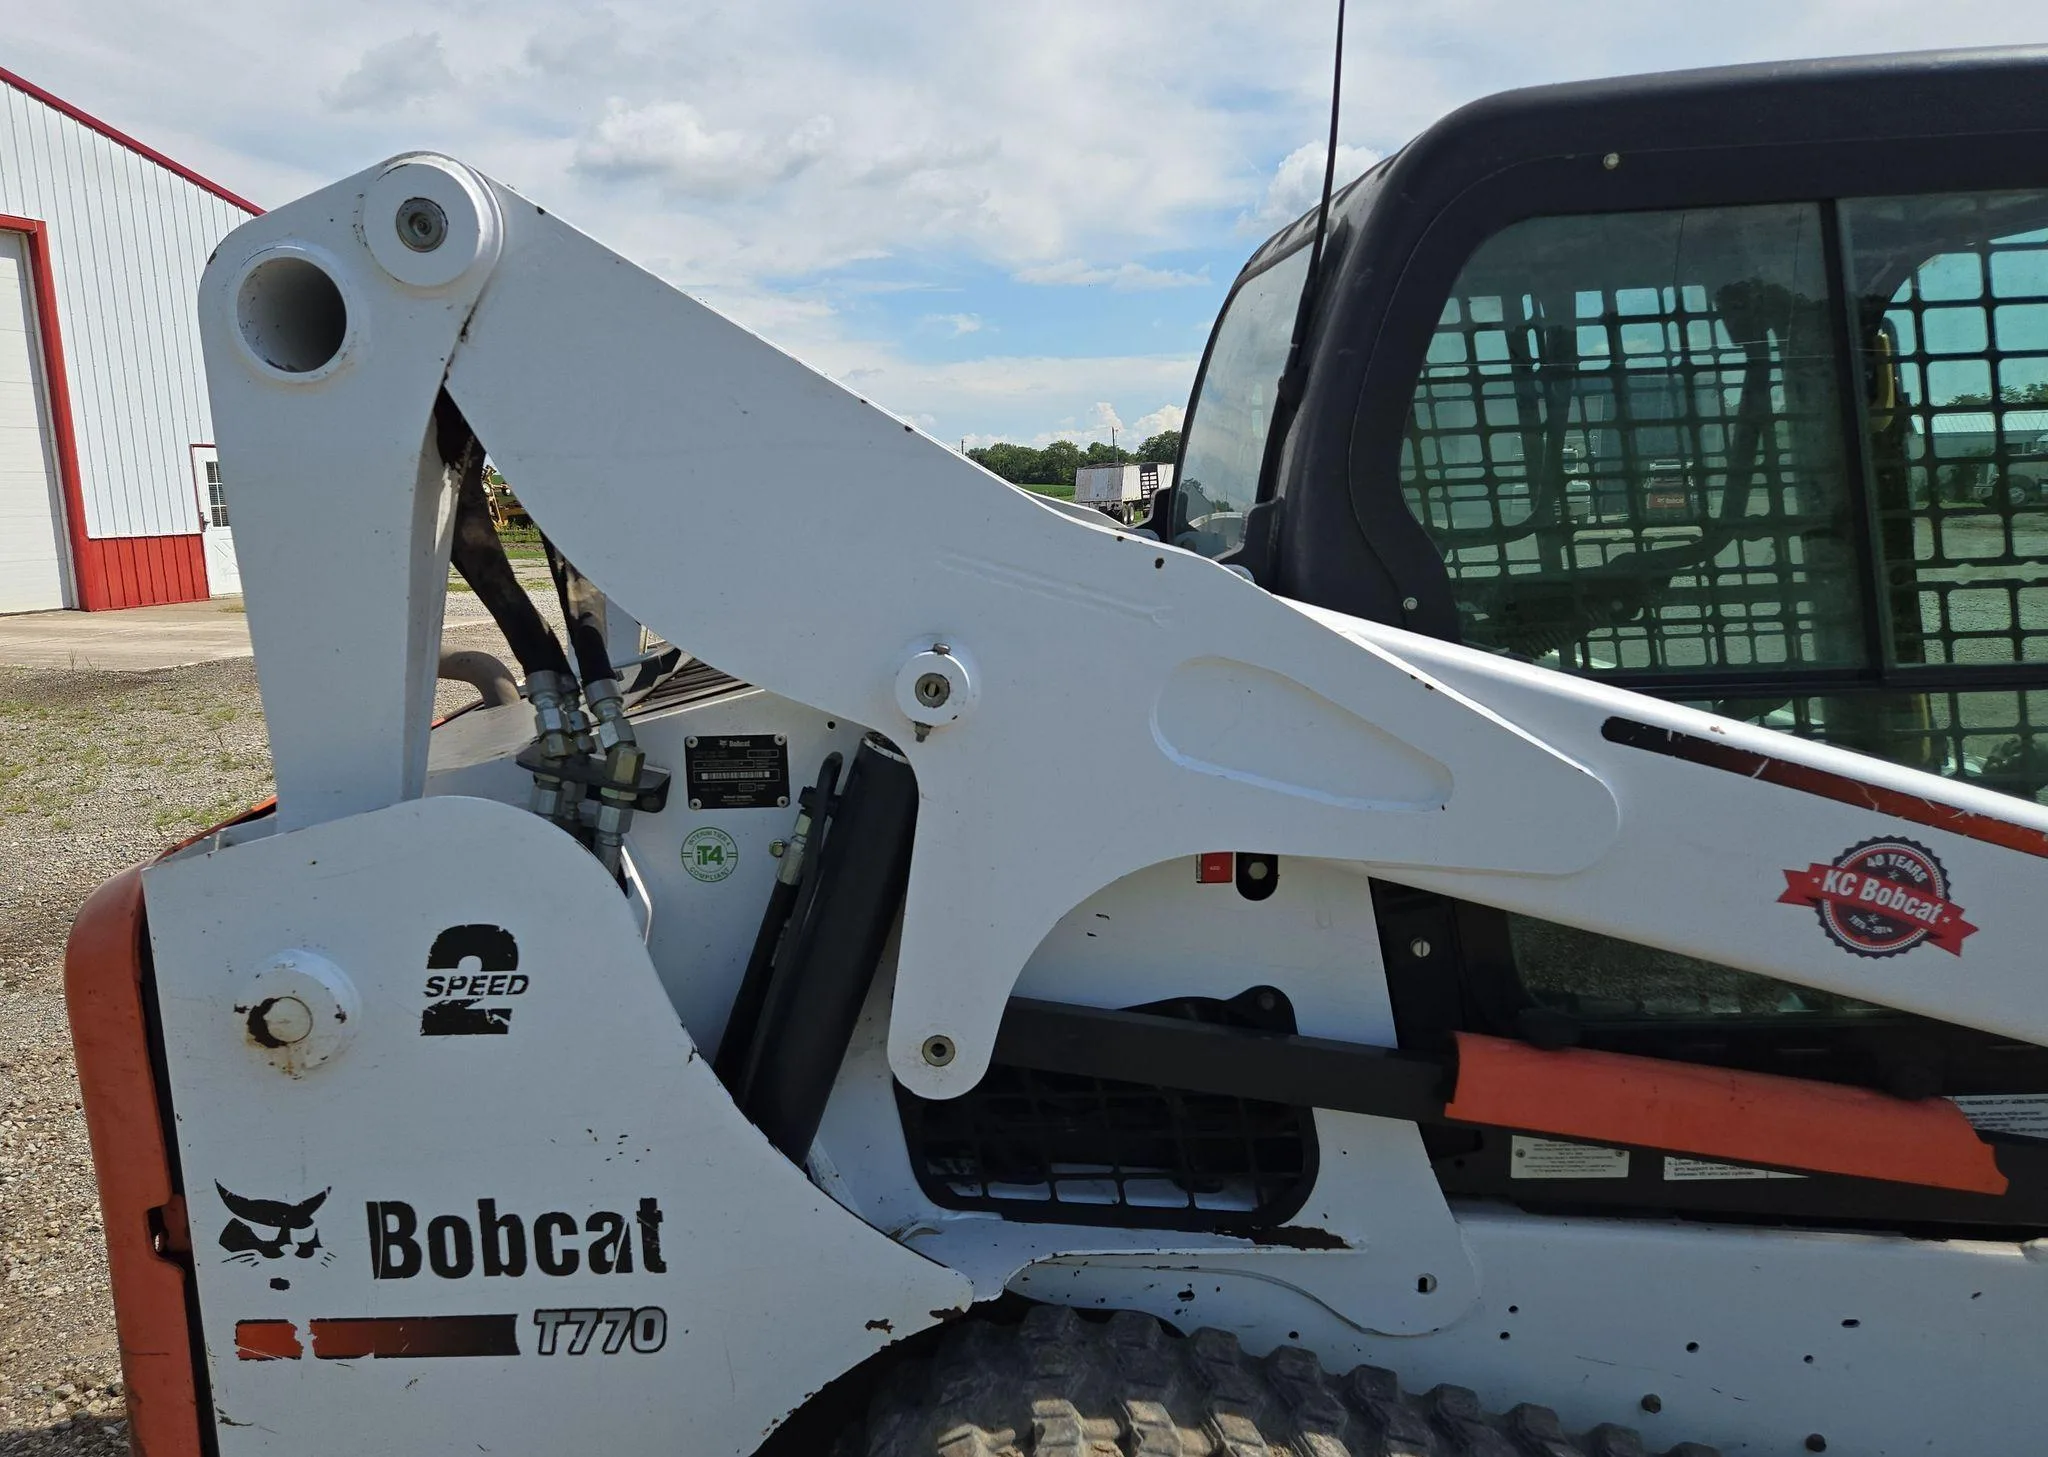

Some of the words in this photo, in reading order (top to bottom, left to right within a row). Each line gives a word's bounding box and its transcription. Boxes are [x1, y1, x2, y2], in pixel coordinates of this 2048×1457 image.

[689, 866, 730, 880] COMPLIANT
[1866, 853, 1885, 868] 40
[1887, 853, 1928, 883] YEARS
[1821, 868, 1858, 896] KC
[1858, 877, 1944, 924] Bobcat
[423, 974, 529, 997] SPEED
[366, 1197, 668, 1281] Bobcat
[533, 1305, 668, 1357] T770
